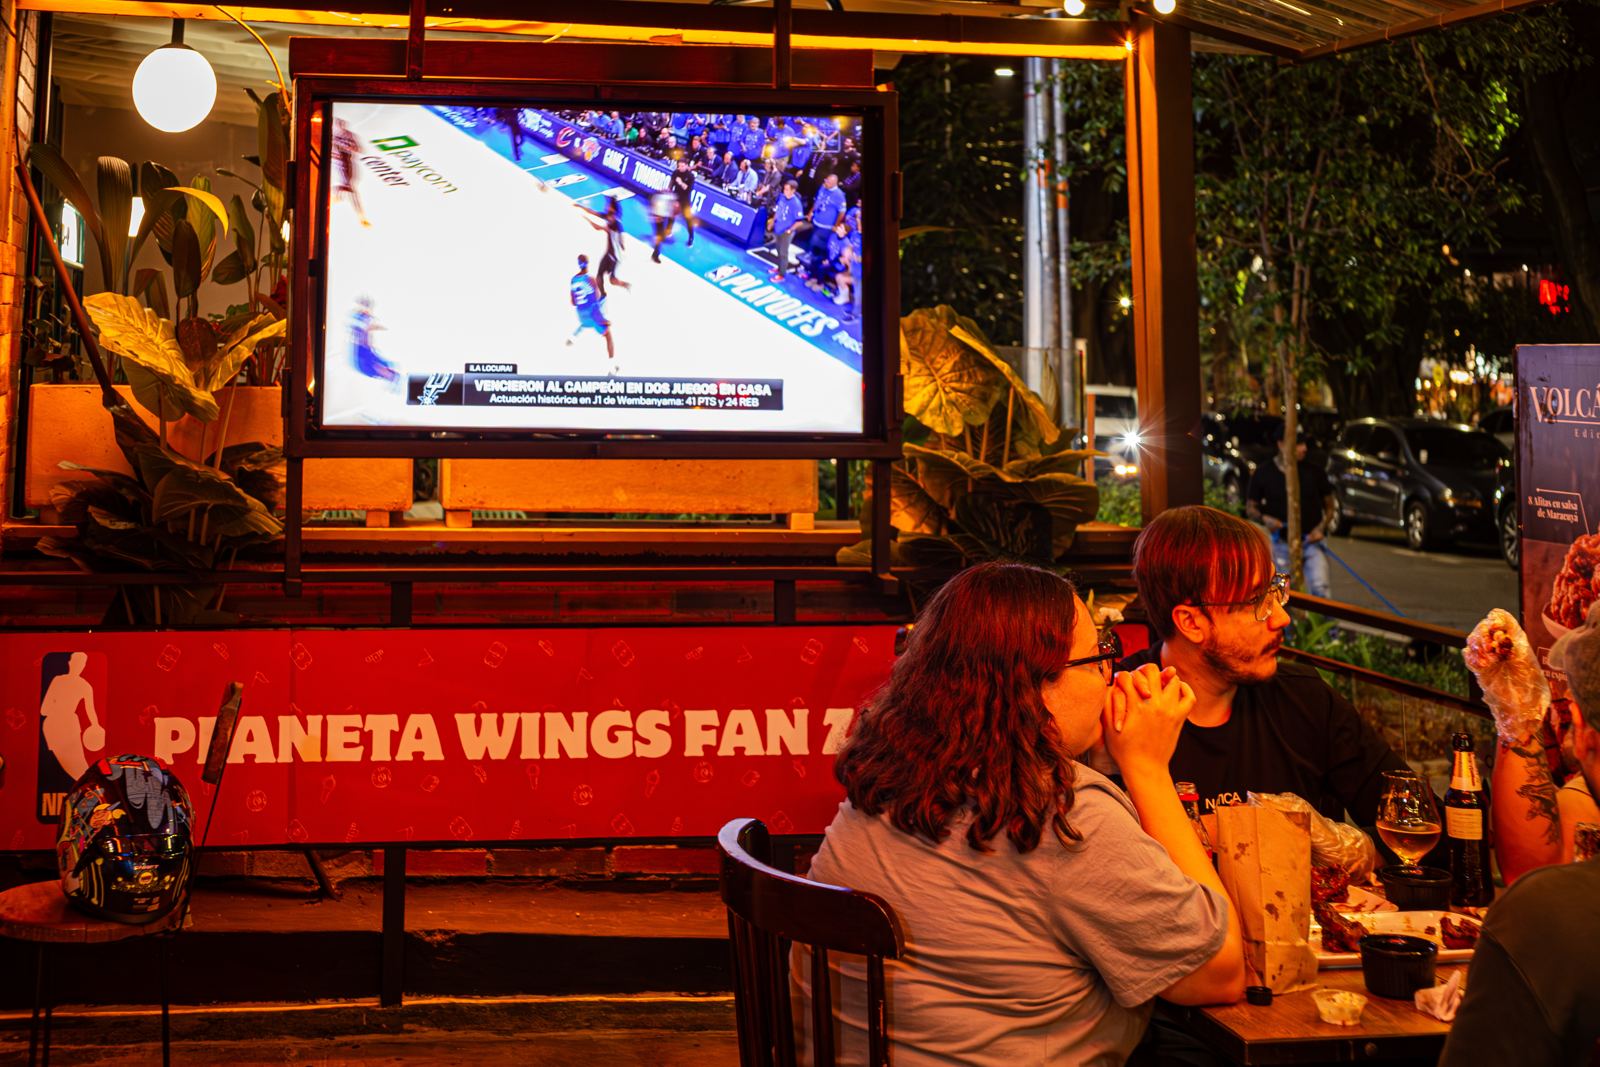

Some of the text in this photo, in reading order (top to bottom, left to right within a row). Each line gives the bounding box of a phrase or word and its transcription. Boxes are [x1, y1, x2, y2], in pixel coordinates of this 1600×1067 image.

[360, 155, 410, 187] center
[386, 149, 458, 194] paycom
[710, 203, 743, 226] ESPN
[720, 273, 839, 336] PLAYOFFS
[474, 379, 772, 396] VENCIERON AL CAMPEÓN EN DOS JUEGOS EN CASA
[489, 393, 536, 404] Actuación
[537, 394, 578, 405] histórica
[579, 396, 592, 405] en
[592, 395, 602, 405] J1
[602, 395, 617, 405] de
[616, 395, 685, 407] Wembanyama:
[685, 396, 696, 406] 41
[697, 397, 717, 407] PTS
[725, 397, 738, 407] 24
[739, 397, 760, 408] REB
[1537, 507, 1579, 524] de Maracuyá
[1561, 500, 1578, 511] salsa
[454, 709, 672, 760] WINGS
[683, 708, 810, 757] FAN
